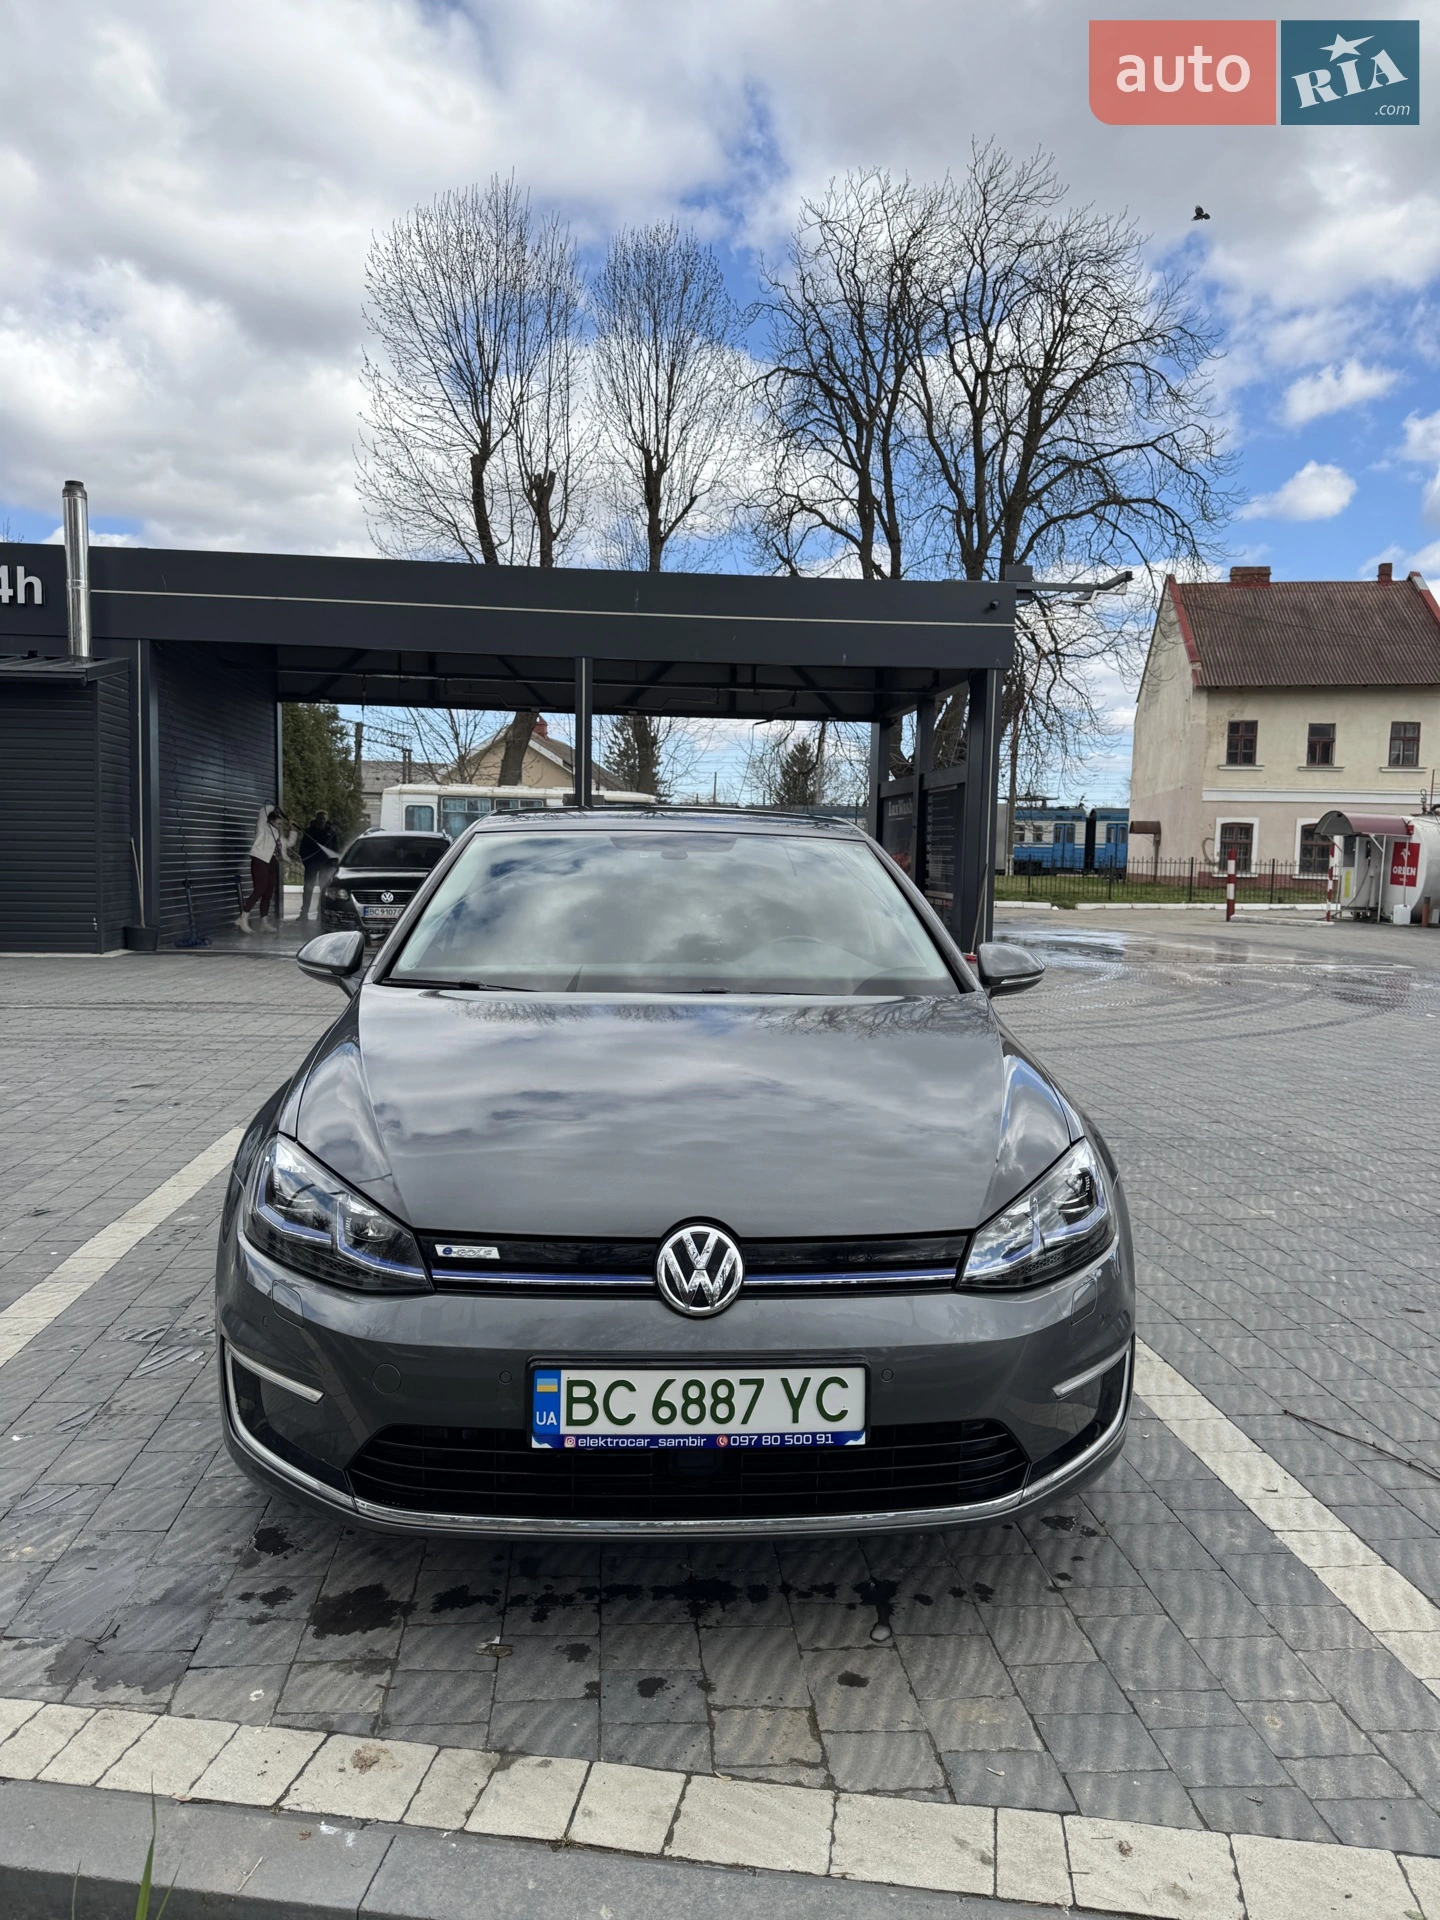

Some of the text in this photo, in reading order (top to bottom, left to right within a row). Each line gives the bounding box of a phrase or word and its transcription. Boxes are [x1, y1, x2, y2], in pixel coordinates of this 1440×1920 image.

[566, 1376, 849, 1427] BC 6887 YC
[536, 1411, 558, 1426] UA
[577, 1433, 834, 1449] elektrocar_sambir 097 80 500 91
